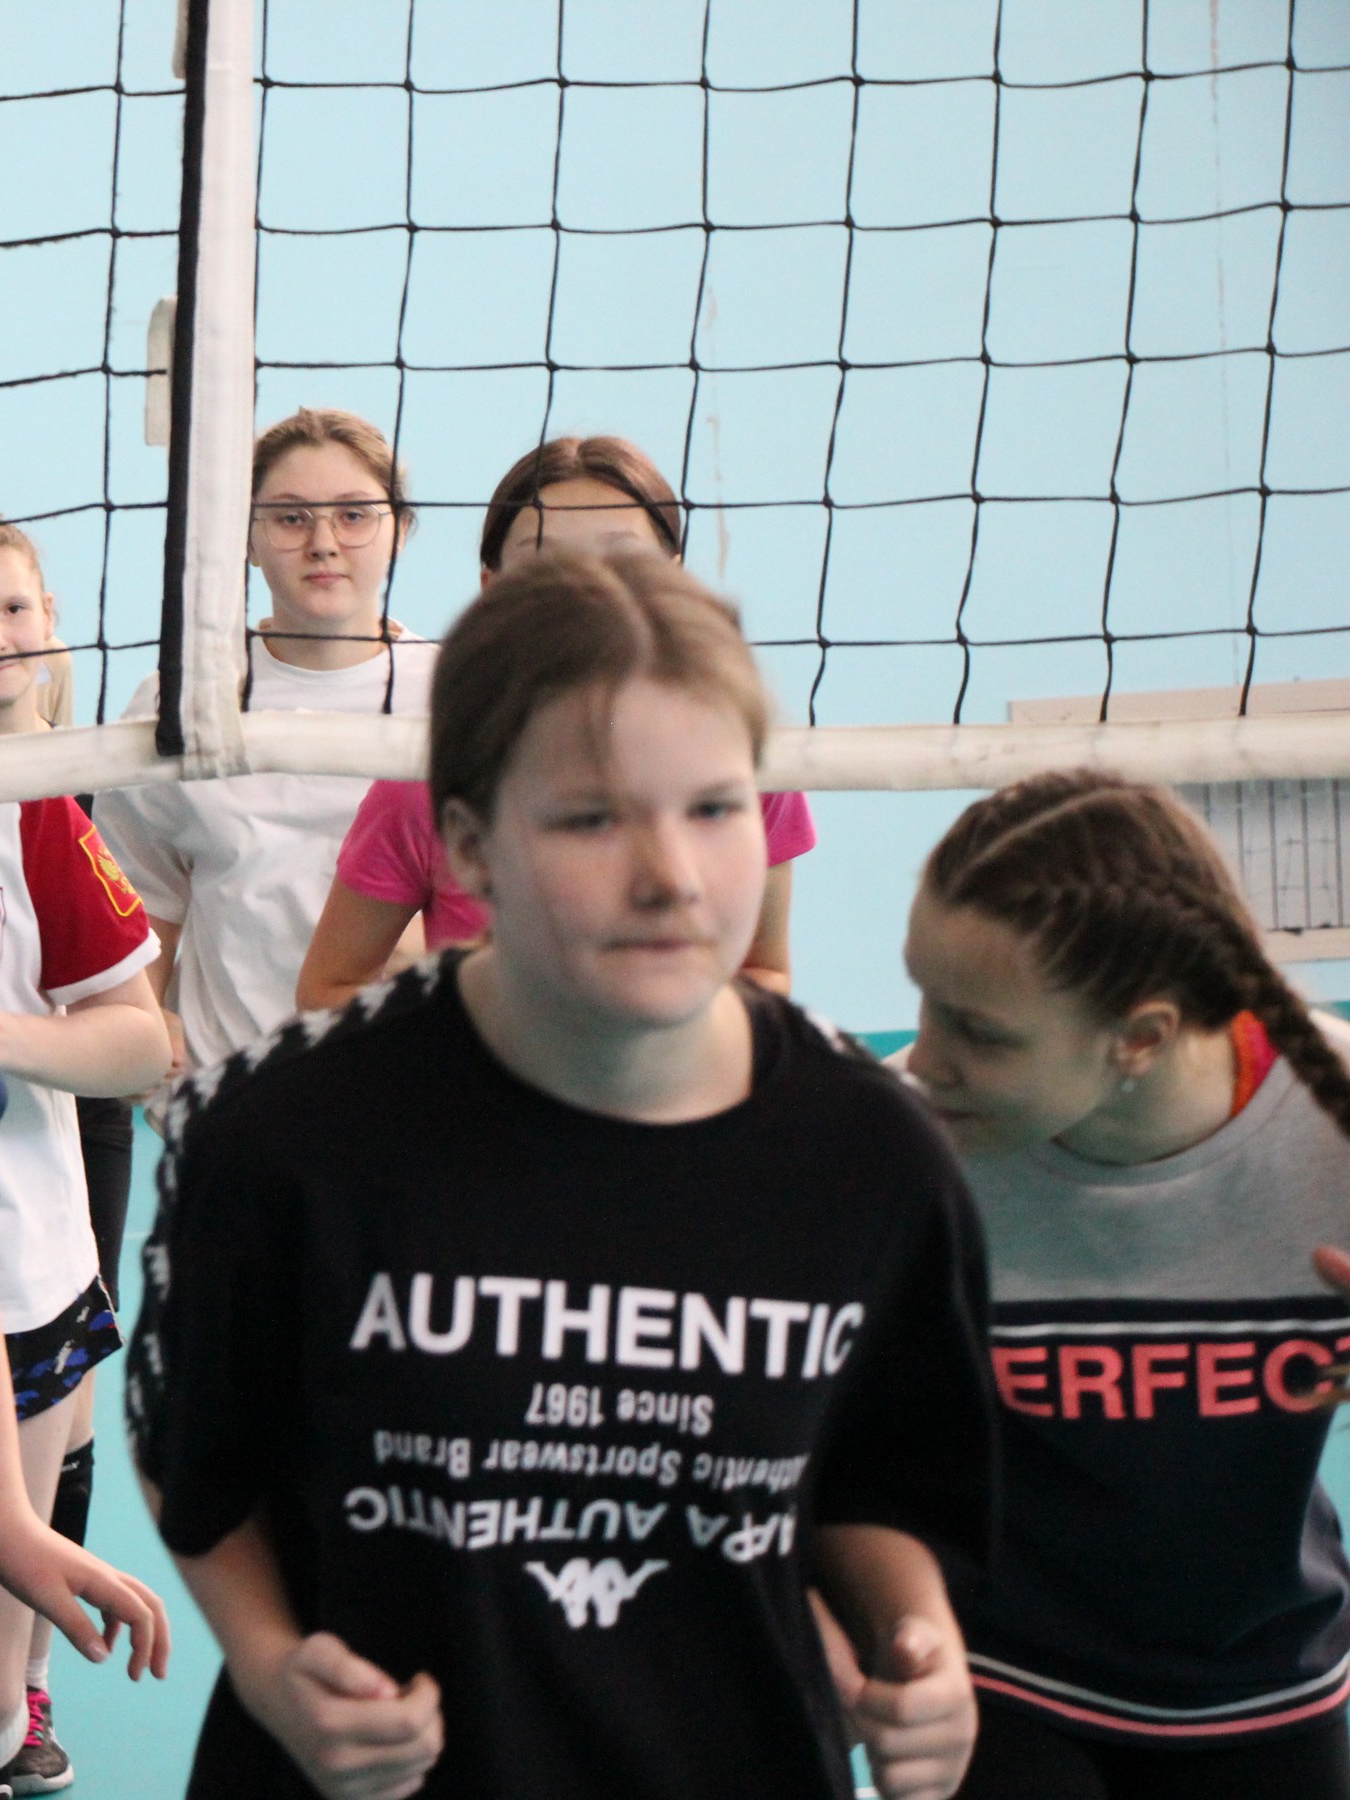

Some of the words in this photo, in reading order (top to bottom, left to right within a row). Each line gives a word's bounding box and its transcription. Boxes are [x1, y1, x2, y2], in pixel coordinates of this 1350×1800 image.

[350, 1272, 864, 1380] AUTHENTIC
[990, 1335, 1350, 1420] ERFEC
[524, 1381, 605, 1428] 1967
[617, 1387, 714, 1437] Since
[373, 1430, 472, 1479] Brand
[482, 1439, 682, 1487] Sportswear
[344, 1486, 668, 1551] AUTHENTIC
